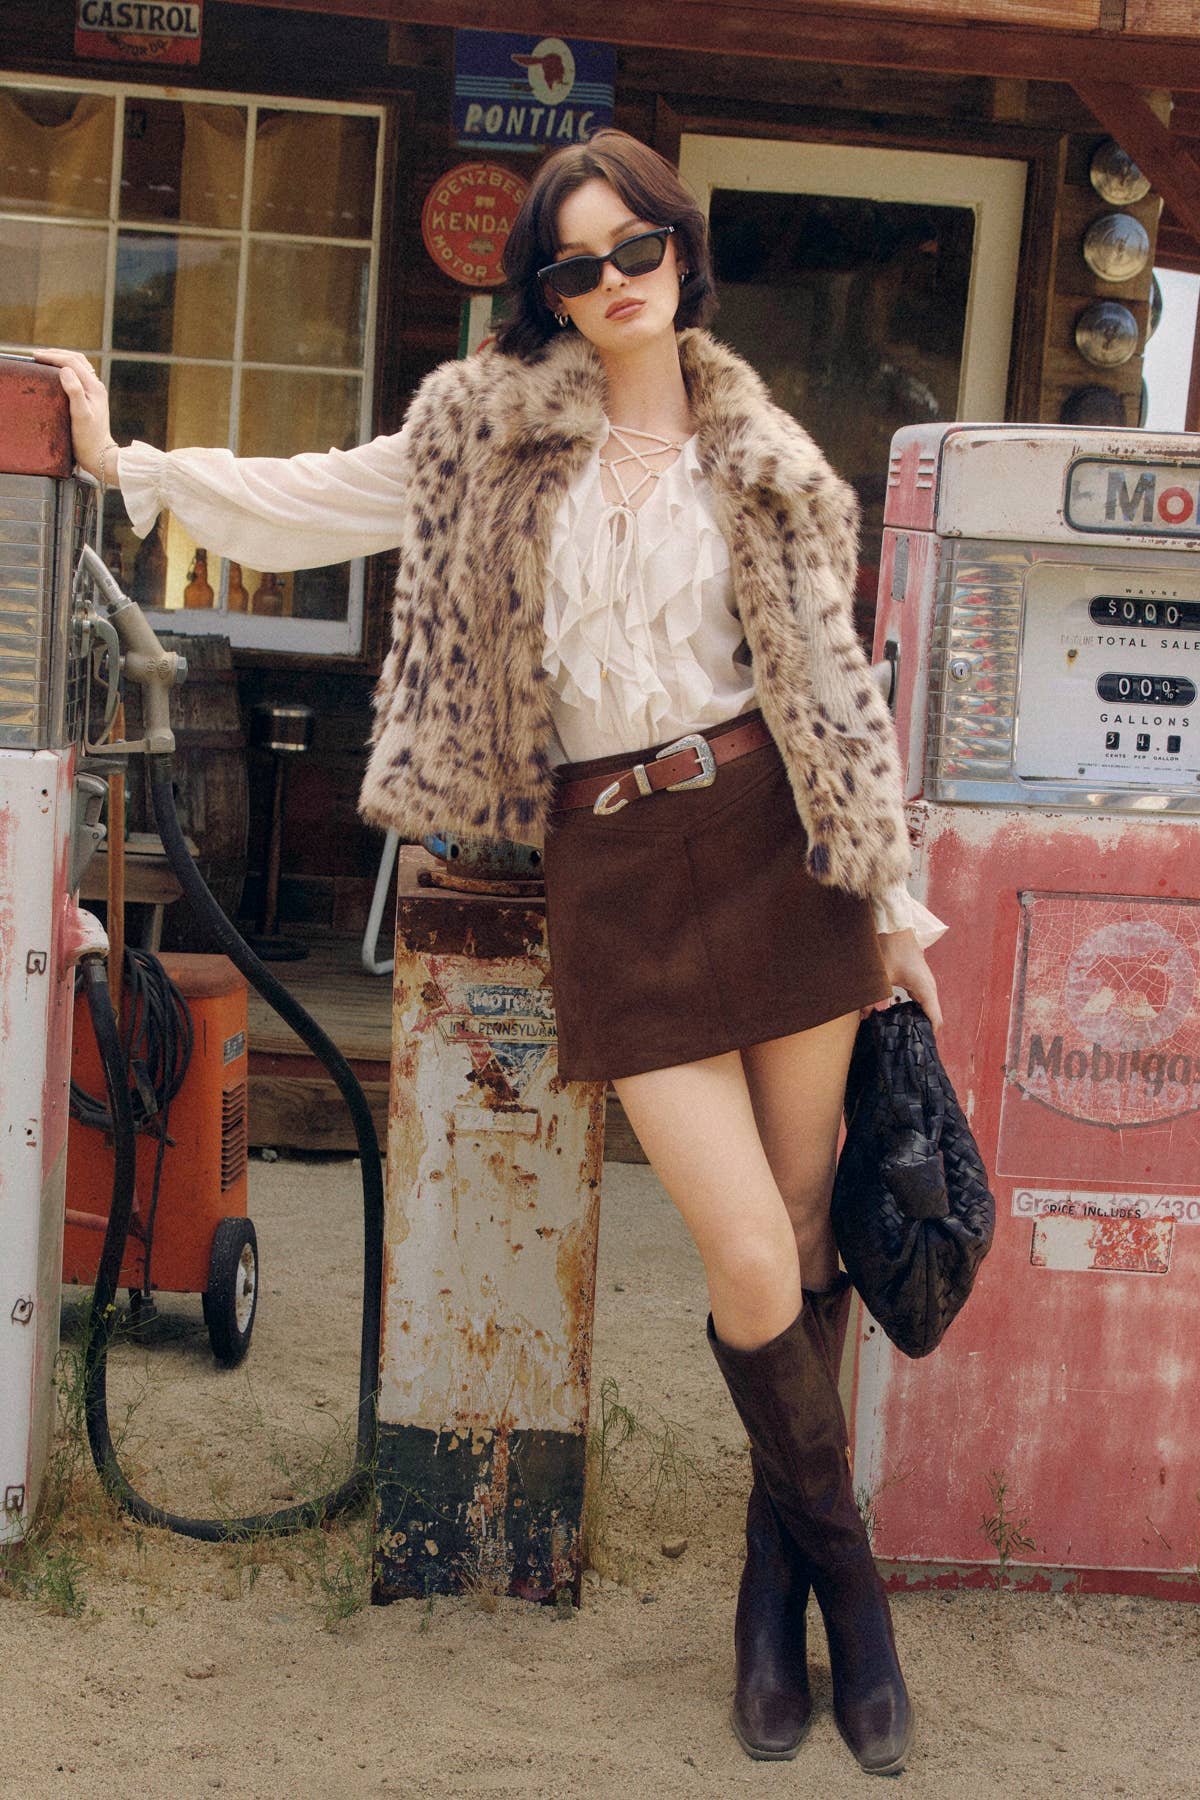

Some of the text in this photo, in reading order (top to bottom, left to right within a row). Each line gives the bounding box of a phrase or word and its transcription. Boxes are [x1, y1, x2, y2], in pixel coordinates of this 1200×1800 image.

[82, 1, 197, 33] CASTROL
[464, 103, 594, 140] PONTIAC
[434, 234, 488, 278] MOTOR
[1104, 472, 1200, 525] Mo
[1125, 588, 1177, 597] WAYNE
[1098, 636, 1200, 650] TOTAL SALE
[1100, 713, 1190, 728] GALLONS
[1027, 1034, 1200, 1097] Mobilga
[1083, 1205, 1142, 1219] INCLUDES
